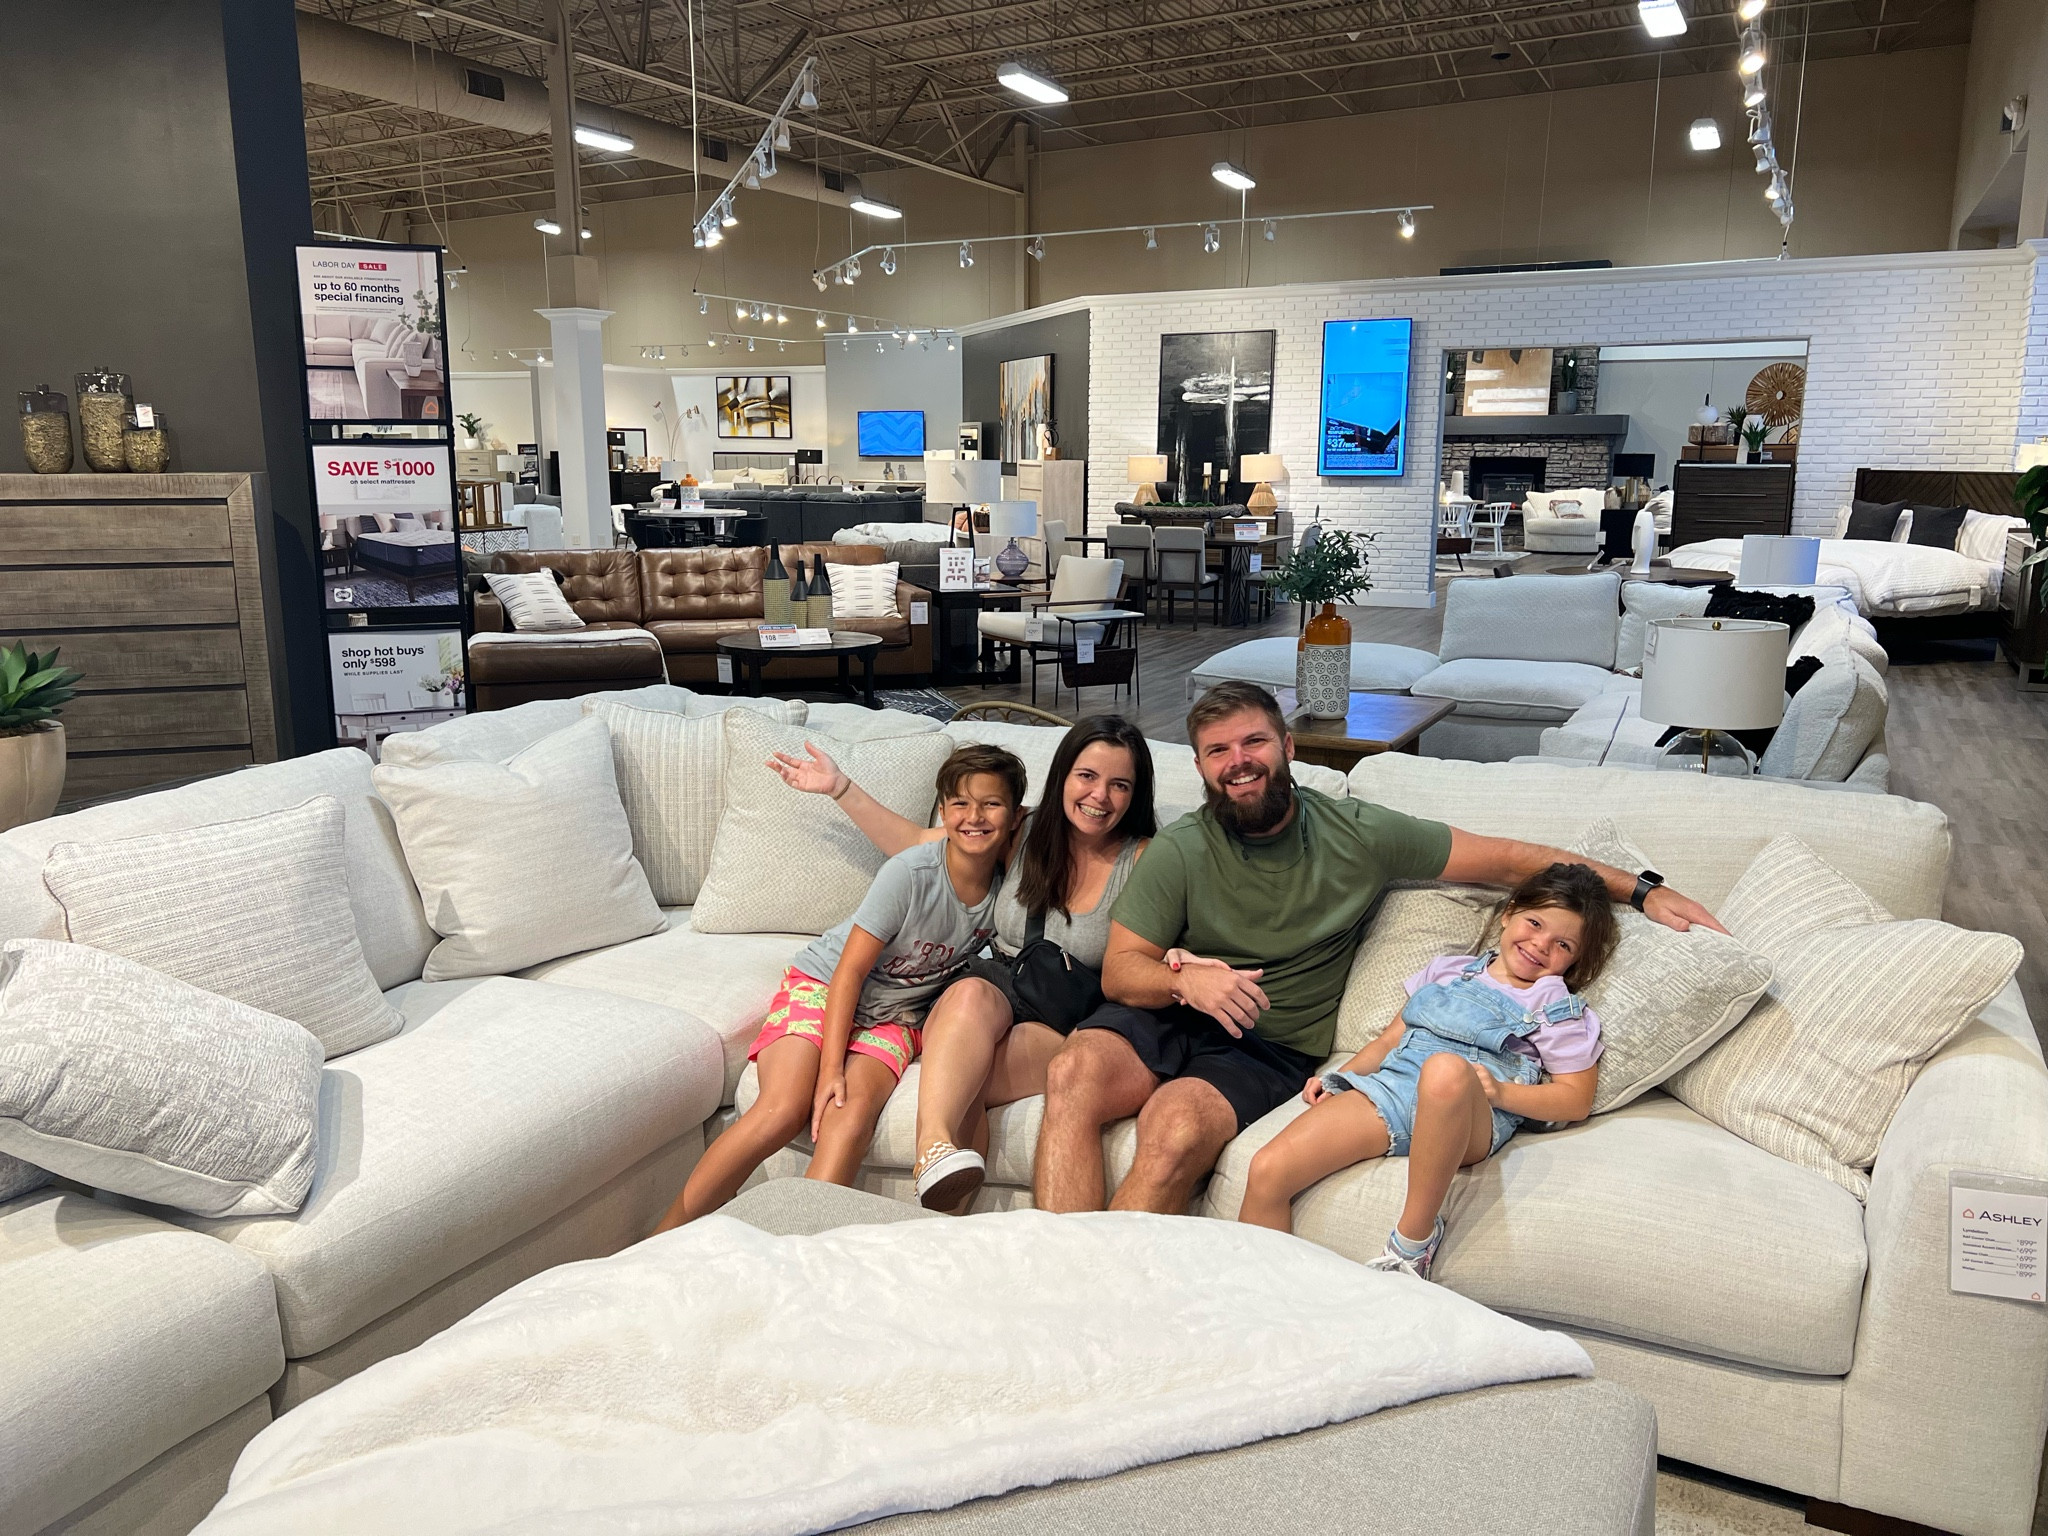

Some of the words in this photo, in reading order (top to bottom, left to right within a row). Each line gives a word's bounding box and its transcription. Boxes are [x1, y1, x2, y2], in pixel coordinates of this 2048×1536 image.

[313, 282, 328, 292] up
[330, 281, 341, 291] to
[344, 282, 357, 291] 60
[360, 284, 400, 293] months
[314, 292, 353, 302] special
[355, 293, 404, 306] financing
[327, 461, 380, 476] SAVE
[384, 459, 435, 476] $1000
[341, 647, 371, 659] shop
[374, 646, 394, 656] hot
[342, 658, 368, 670] only
[370, 657, 396, 668] $598
[1979, 1210, 2043, 1227] ASHLEY
